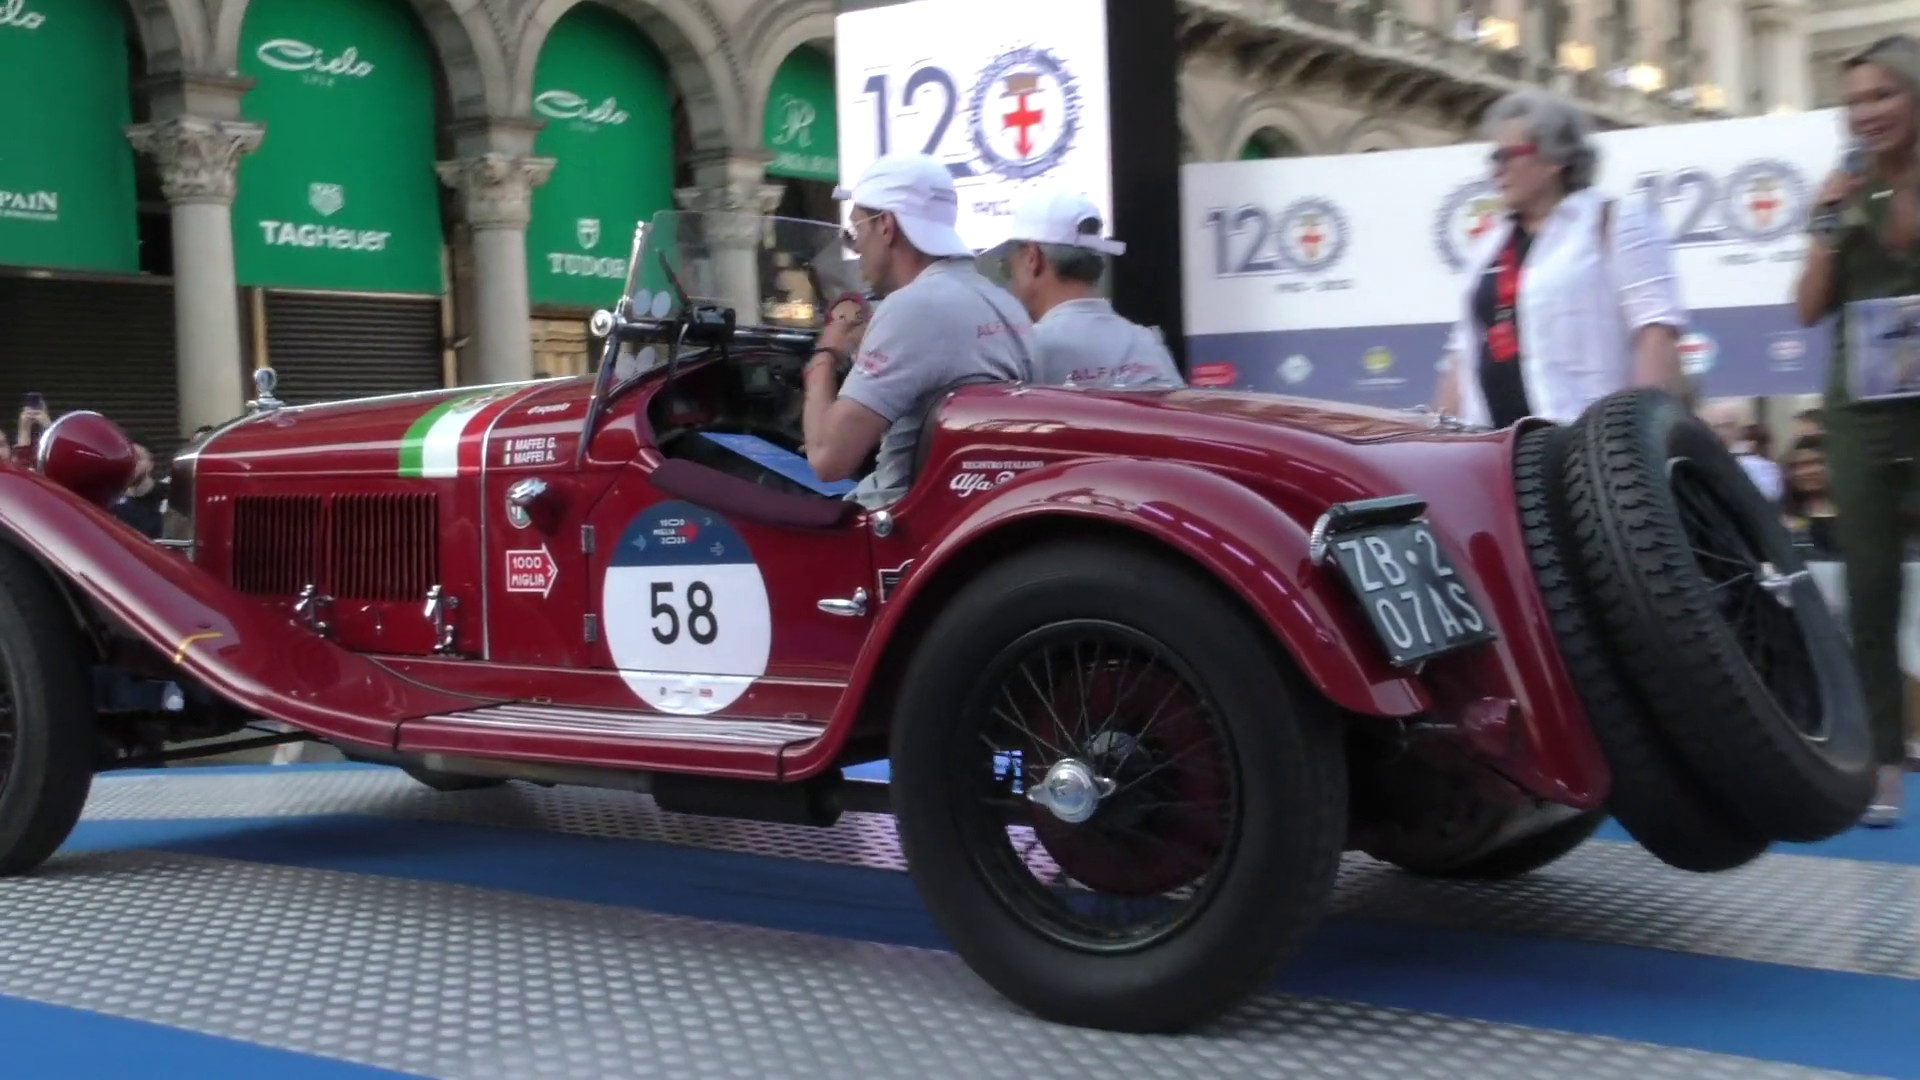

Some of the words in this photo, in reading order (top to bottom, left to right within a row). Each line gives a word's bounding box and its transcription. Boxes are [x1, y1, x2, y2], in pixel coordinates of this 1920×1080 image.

[514, 438, 546, 450] MAFFEI
[547, 437, 557, 448] G.
[513, 451, 545, 464] MAFFEI
[546, 450, 556, 461] A.
[512, 557, 542, 569] 1000
[511, 573, 546, 587] MIGLIA
[651, 580, 719, 645] 58
[1376, 582, 1484, 649] 07AS
